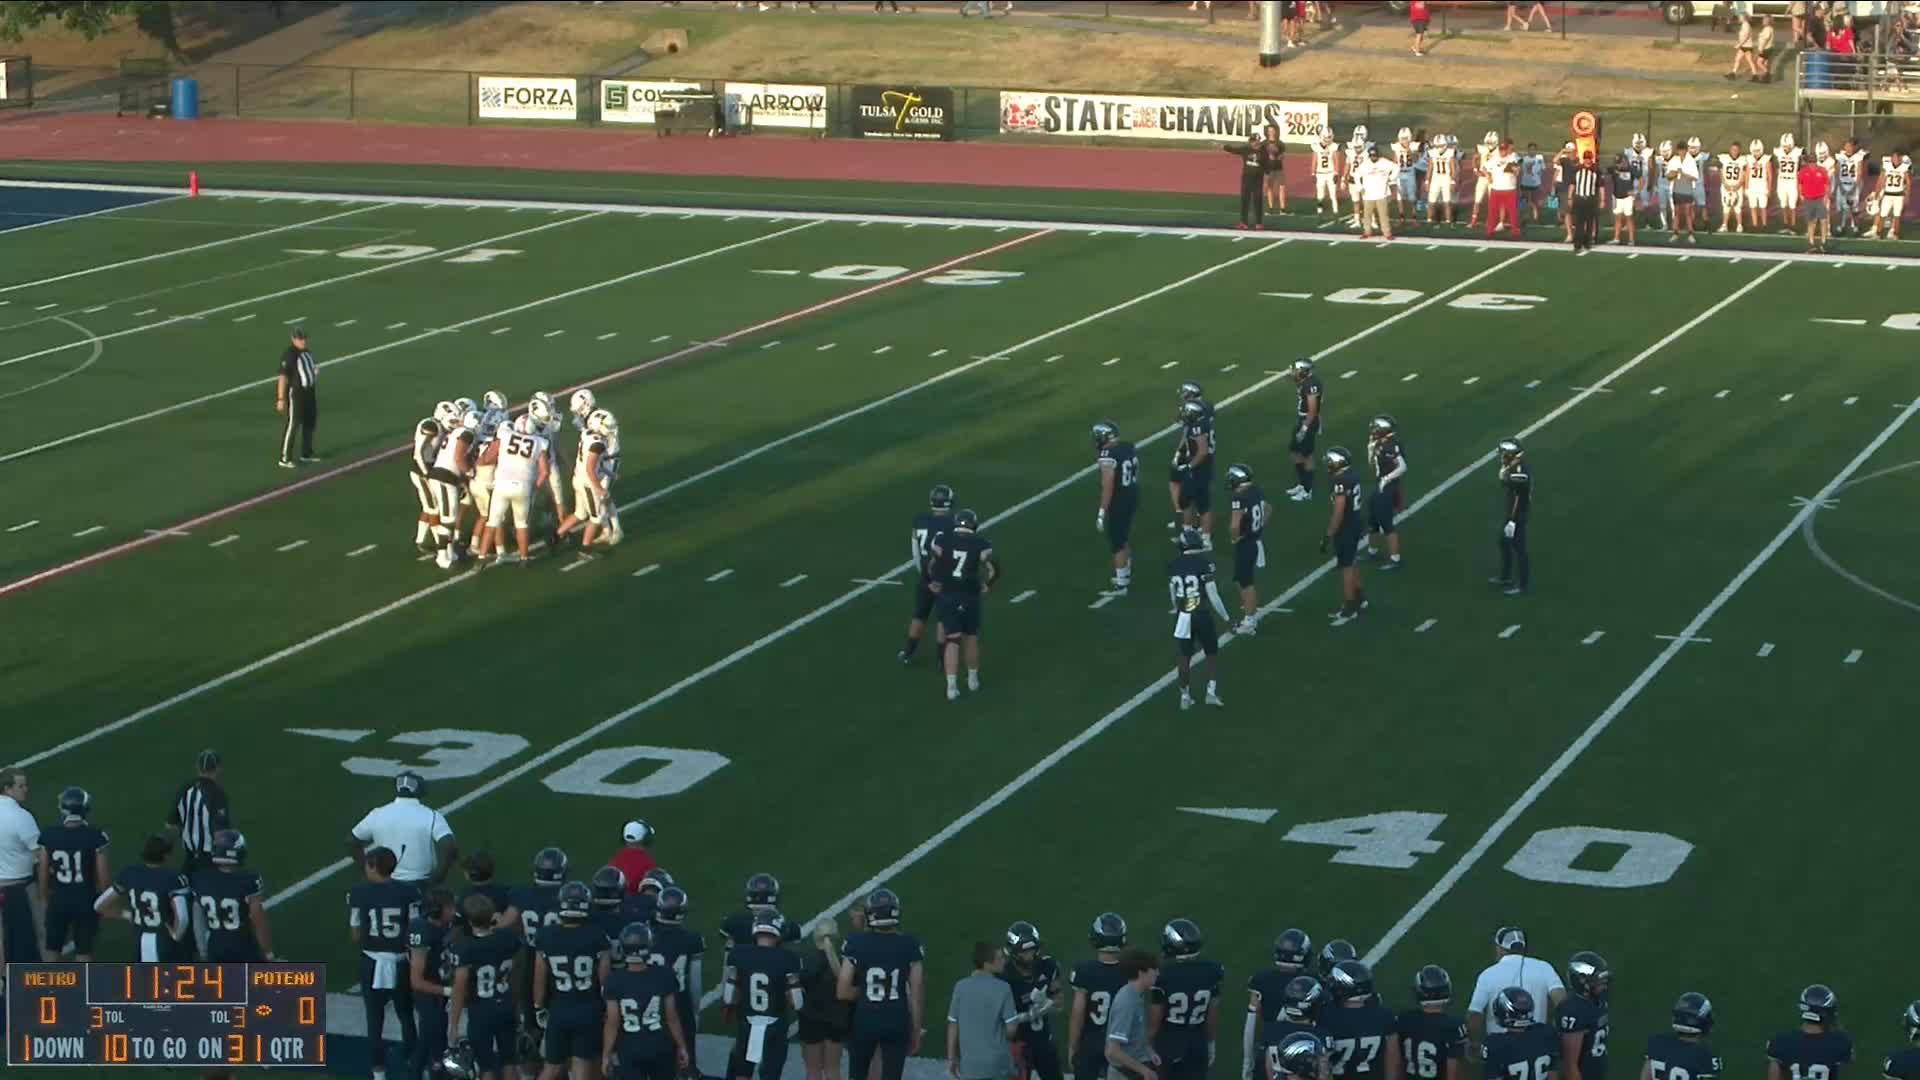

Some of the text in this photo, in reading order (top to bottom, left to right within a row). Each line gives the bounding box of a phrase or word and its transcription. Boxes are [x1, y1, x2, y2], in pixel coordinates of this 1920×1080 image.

[504, 87, 573, 106] FORZA
[751, 94, 824, 111] ARROW
[860, 105, 897, 117] TULSA
[909, 106, 943, 119] GOLD
[1044, 96, 1281, 137] STATE CHAMPS
[1321, 156, 1329, 169] 2
[1436, 160, 1446, 174] 11
[1726, 166, 1740, 180] 59
[1751, 166, 1763, 179] 31
[1780, 160, 1795, 173] 23
[1841, 163, 1856, 178] 24
[1887, 174, 1902, 187] 33
[507, 434, 535, 459] 53
[952, 549, 968, 578] 7
[52, 850, 84, 884] 31
[129, 888, 161, 927] 13
[200, 895, 241, 931] 33
[368, 907, 402, 939] 15
[548, 955, 594, 992] 59
[866, 966, 900, 1002] 61
[750, 971, 770, 1012] 6
[621, 996, 661, 1033] 64
[1167, 989, 1212, 1025] 22
[1561, 1016, 1577, 1030] 67
[1332, 1035, 1381, 1075] 77
[1403, 1037, 1438, 1078] 16
